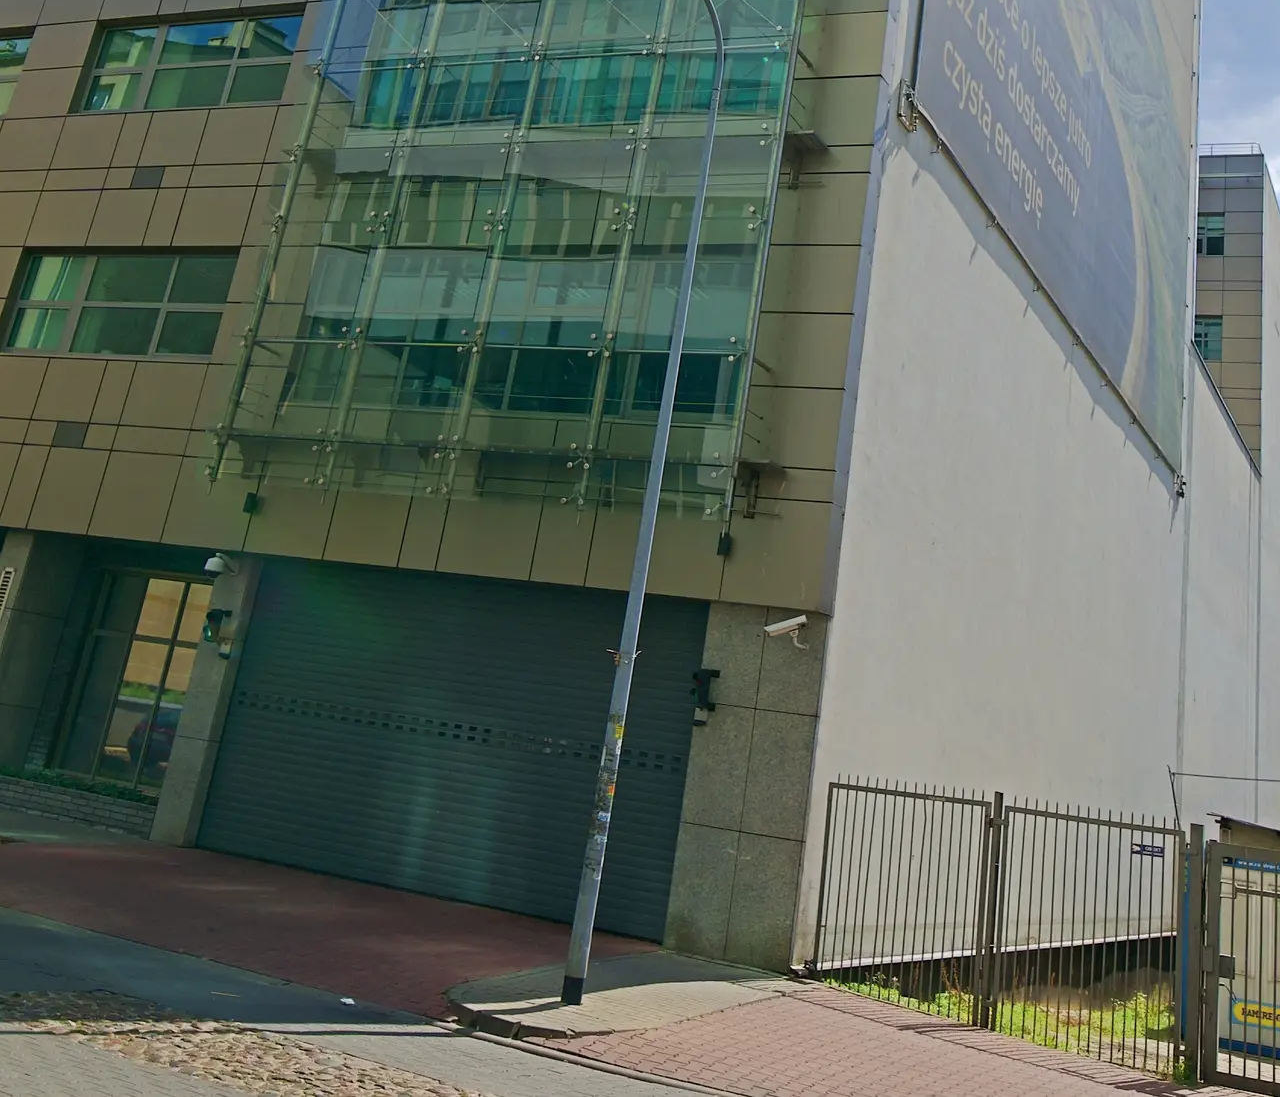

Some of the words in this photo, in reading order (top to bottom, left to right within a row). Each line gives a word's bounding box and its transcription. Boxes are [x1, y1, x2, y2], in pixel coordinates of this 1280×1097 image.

[943, 40, 992, 153] czystą
[995, 122, 1043, 230] energię
[977, 8, 1005, 82] dziś
[1008, 62, 1080, 217] dostarczamy
[1021, 19, 1029, 50] o
[1031, 26, 1067, 122] lepsze
[1067, 100, 1091, 169] jutro
